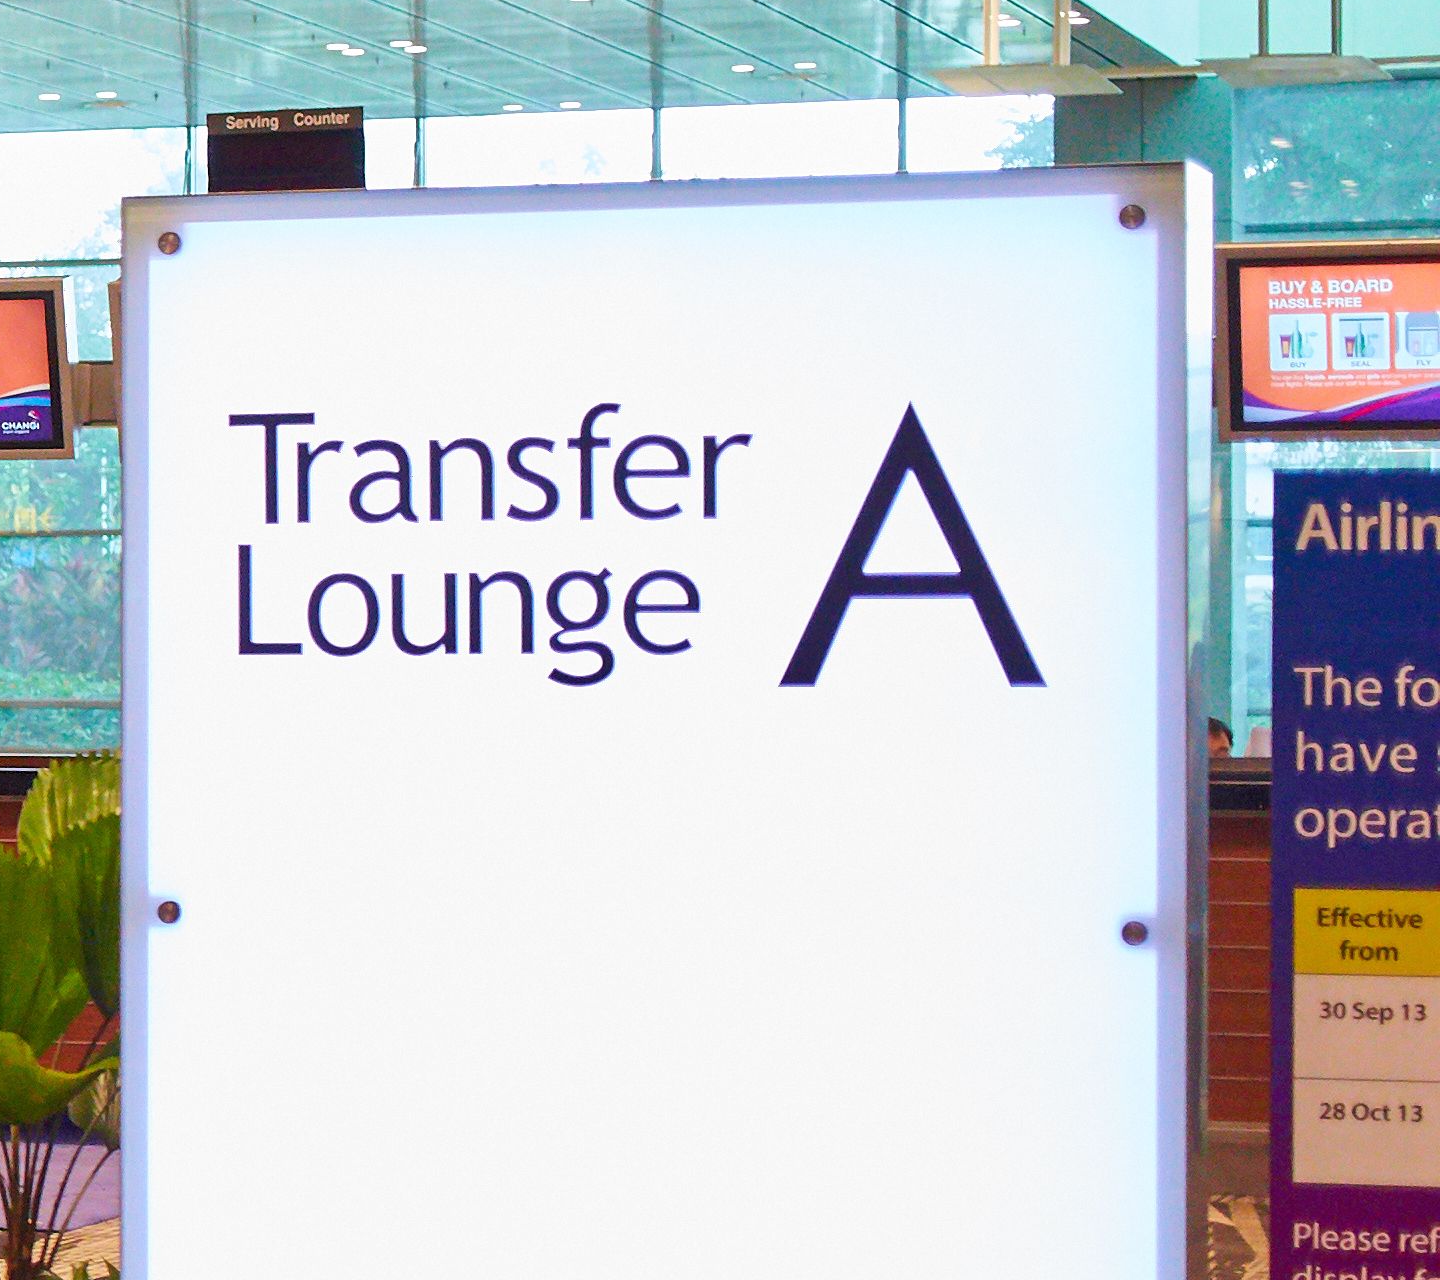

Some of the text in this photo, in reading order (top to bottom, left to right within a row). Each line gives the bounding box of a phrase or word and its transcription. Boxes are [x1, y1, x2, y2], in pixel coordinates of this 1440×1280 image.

[226, 112, 350, 131] Serving Counter
[1268, 279, 1393, 294] BUY & BOARD
[1268, 297, 1362, 309] HASSLE-FREE
[228, 402, 753, 526] Transfer
[777, 402, 1048, 688] A
[236, 542, 702, 688] Lounge
[1293, 665, 1440, 707] The fo
[1295, 731, 1418, 773] have
[1316, 906, 1424, 929] Effective
[1340, 939, 1399, 961] from
[1320, 1001, 1426, 1025] 30 Sep 13
[1319, 1102, 1423, 1123] 28 Oct 13
[1293, 1222, 1440, 1253] Please ref
